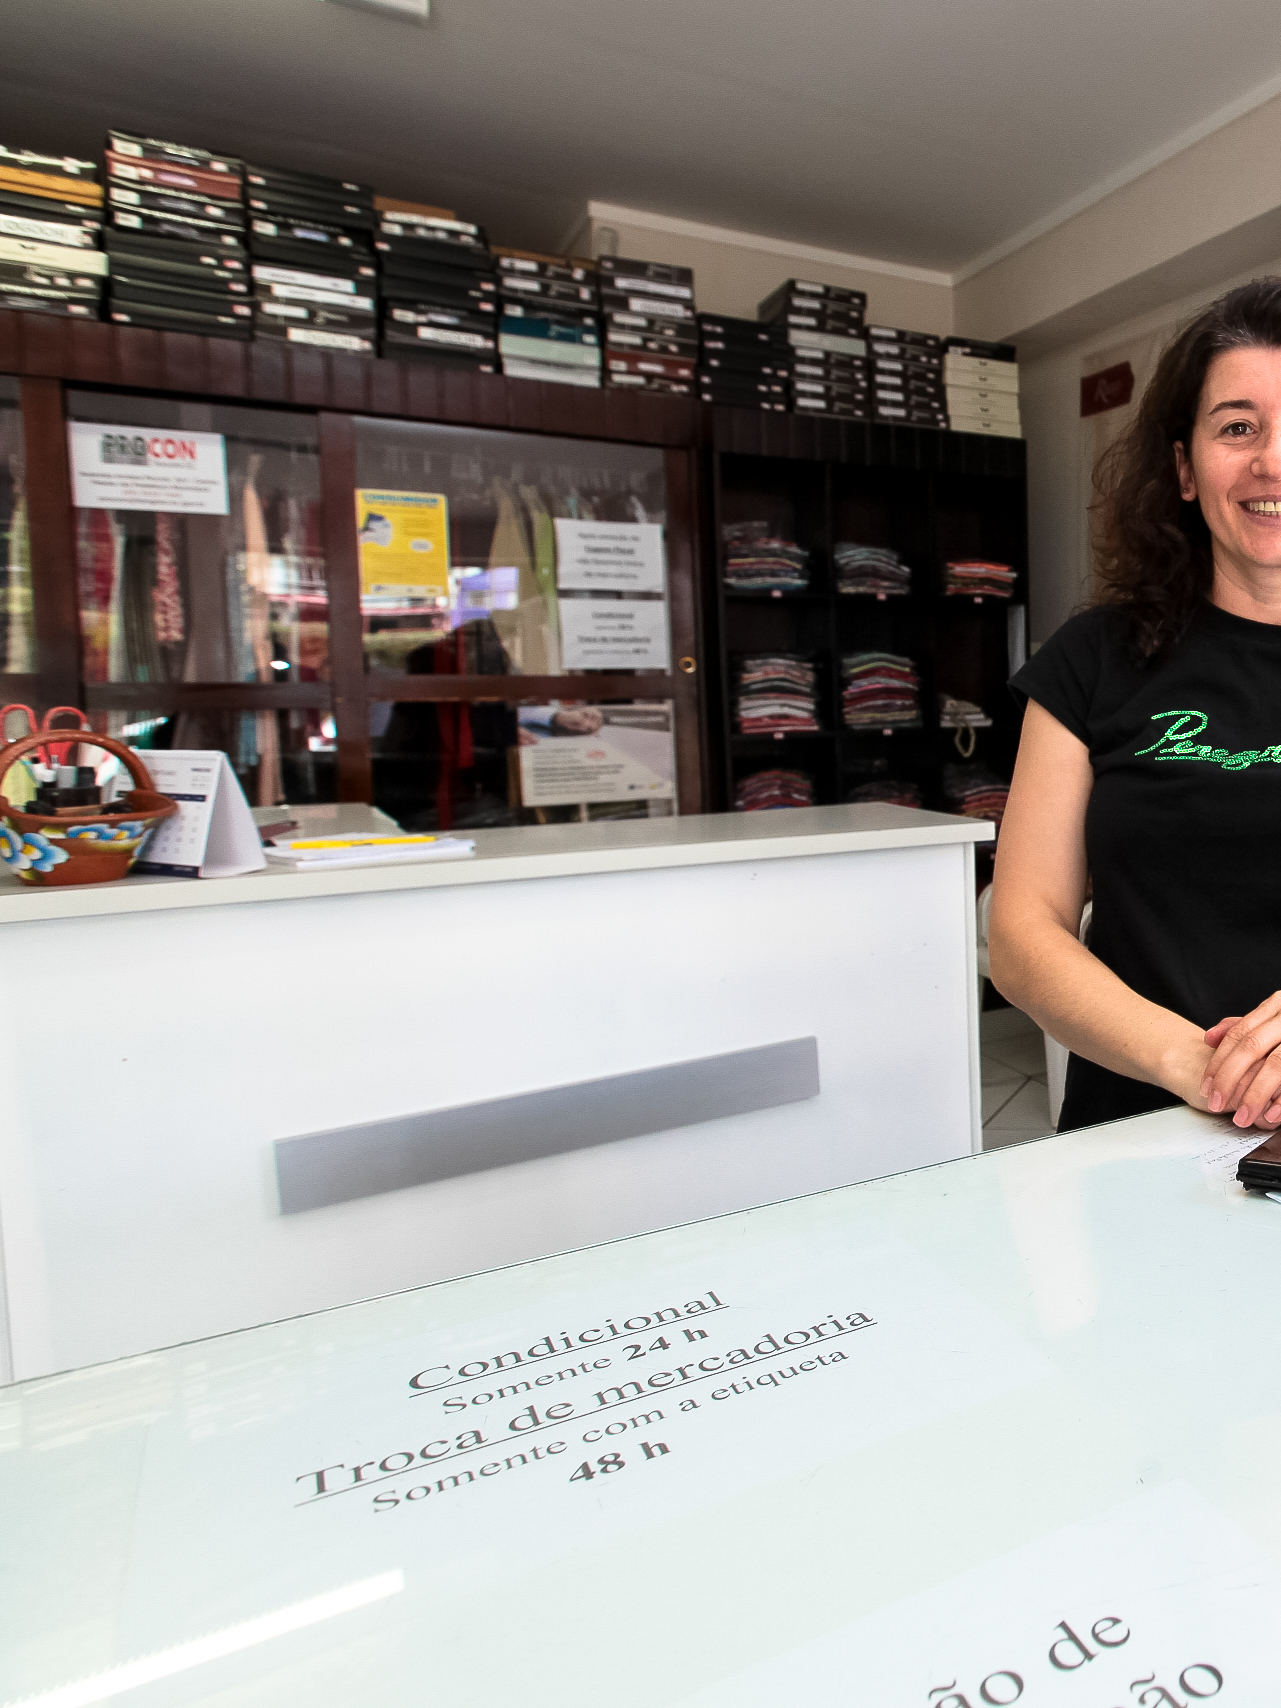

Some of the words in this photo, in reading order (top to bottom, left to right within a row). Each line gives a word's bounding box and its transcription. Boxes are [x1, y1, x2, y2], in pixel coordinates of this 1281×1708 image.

[103, 433, 197, 460] PROCON
[408, 1290, 727, 1392] Condicional
[442, 1357, 613, 1416] Somente
[621, 1335, 672, 1362] 24
[683, 1325, 710, 1344] h
[296, 1428, 489, 1498] Troca
[508, 1397, 575, 1433] de
[595, 1309, 875, 1407] mercadoria
[372, 1438, 568, 1514] Somente
[581, 1407, 666, 1445] com
[678, 1398, 702, 1414] a
[710, 1350, 850, 1402] etiqueta
[567, 1451, 627, 1484] 48
[640, 1438, 673, 1461] h
[1048, 1617, 1131, 1672] de
